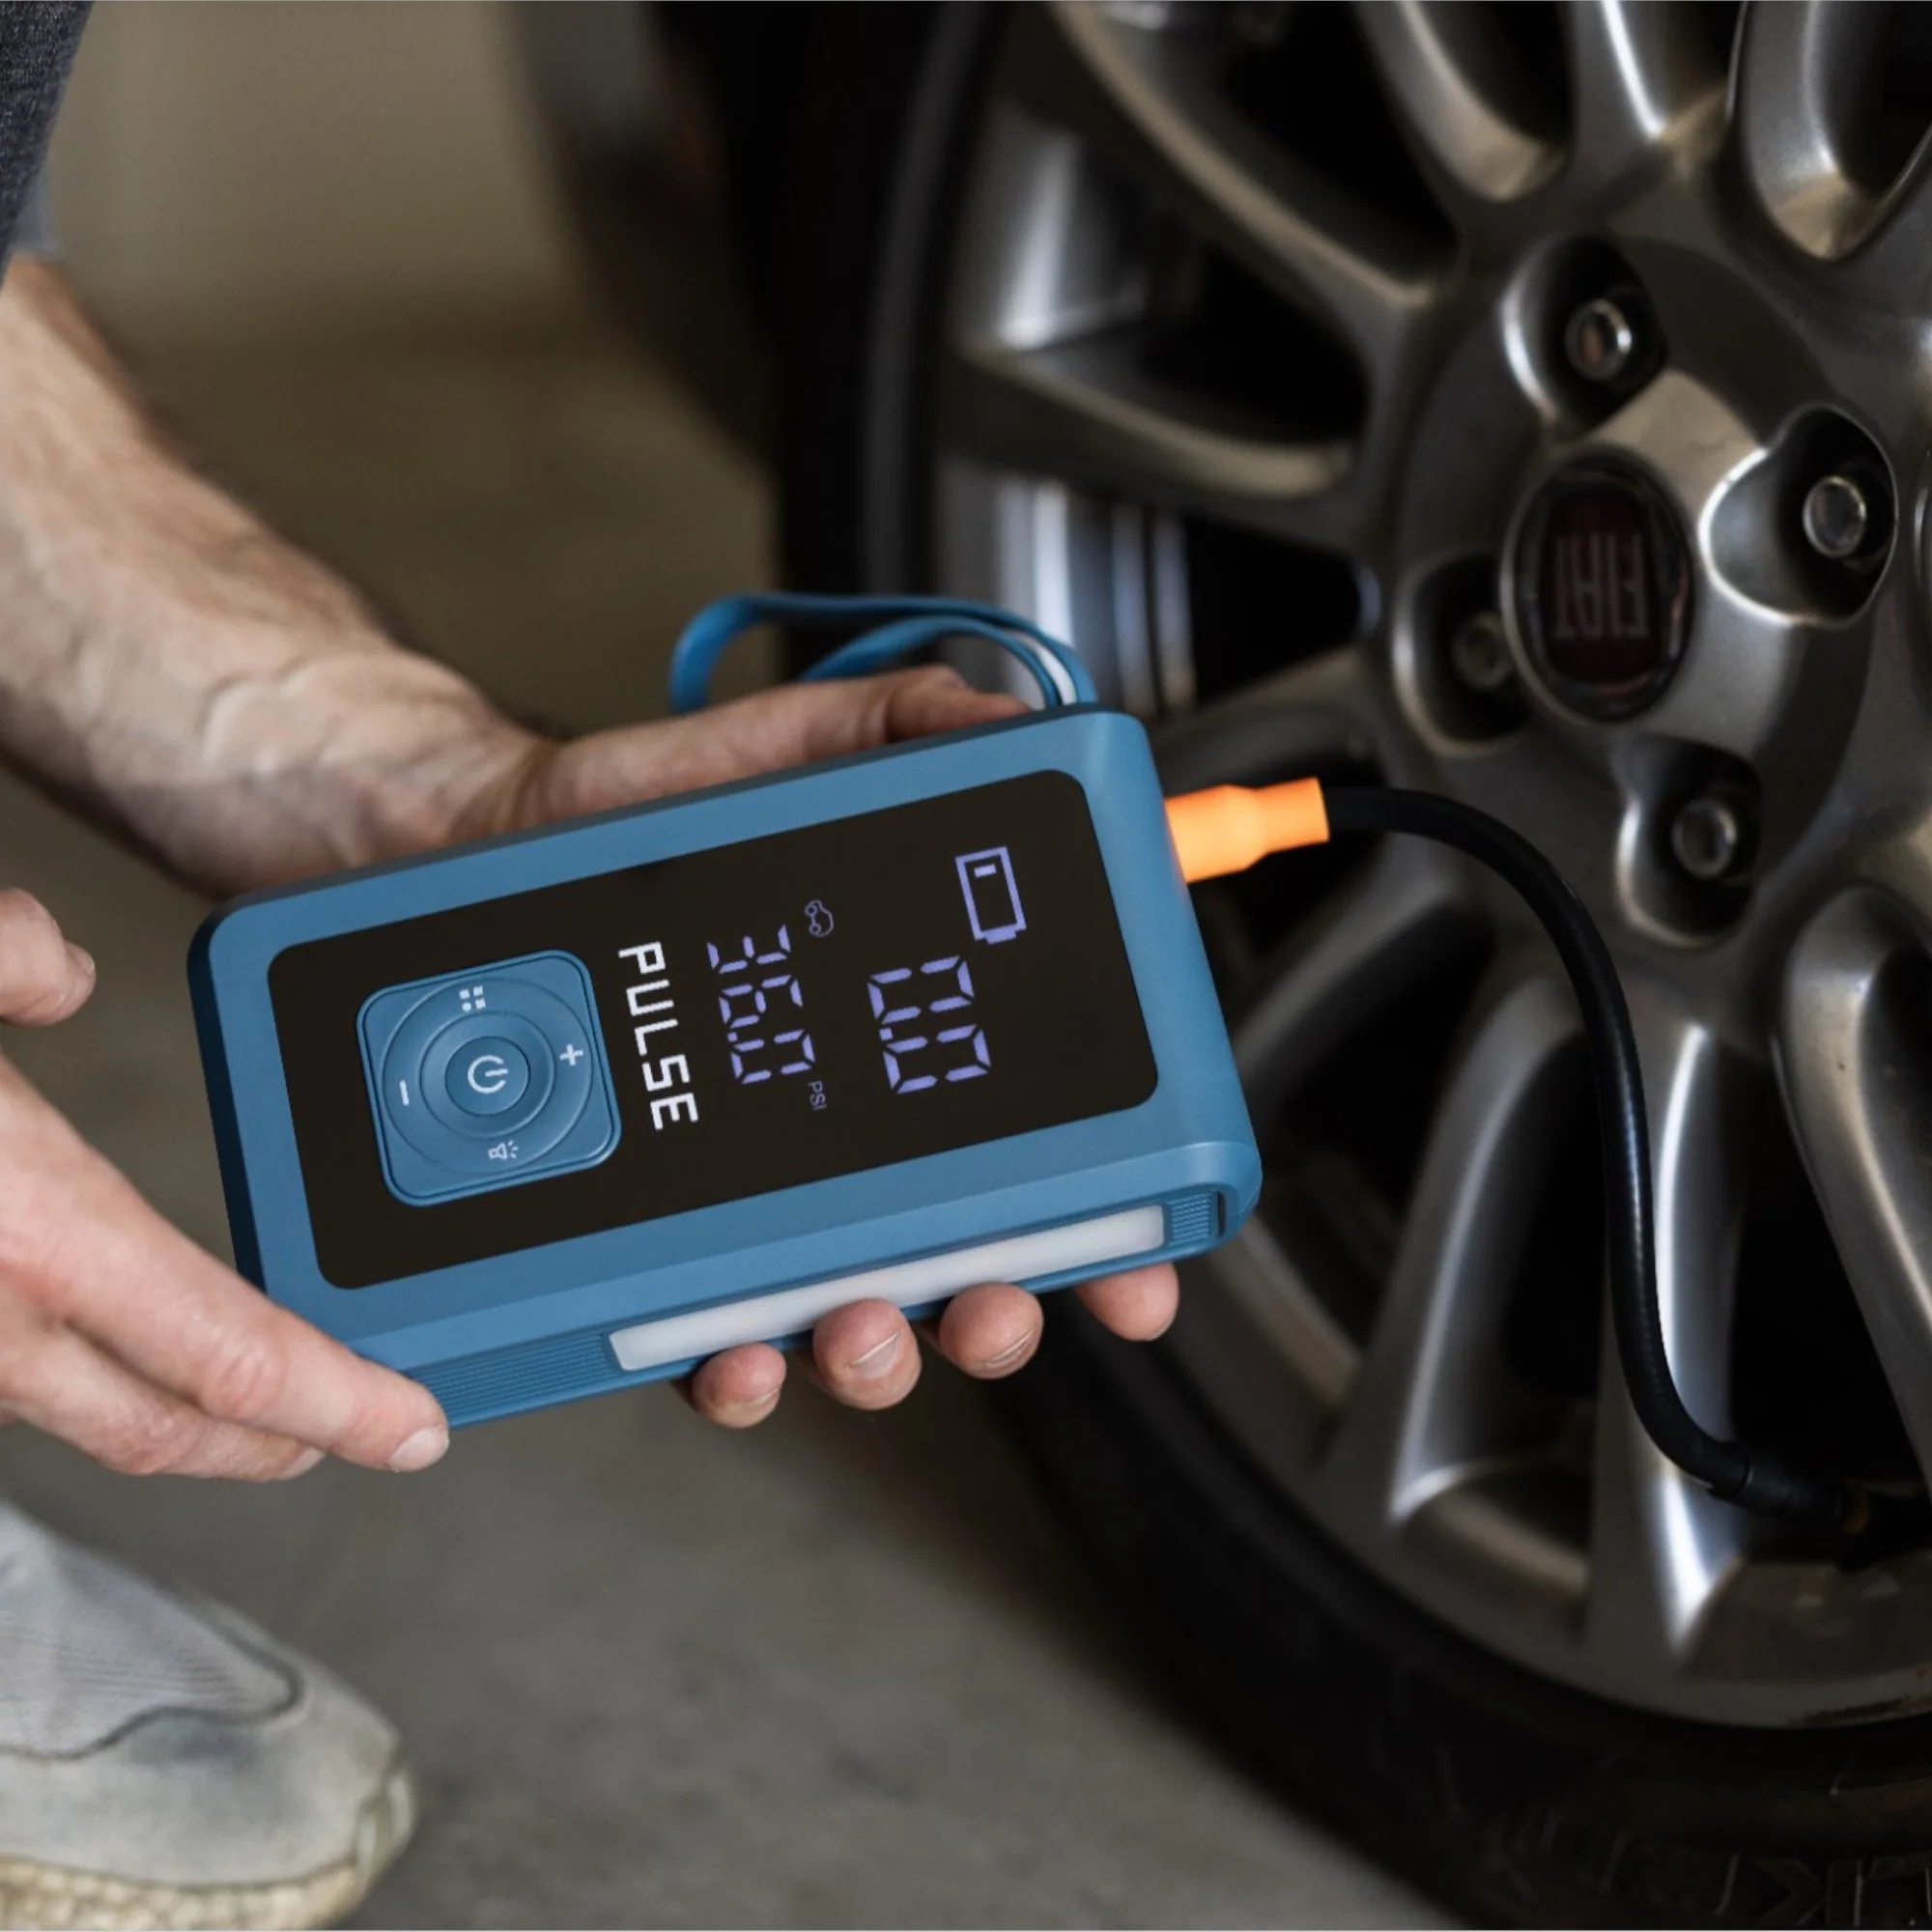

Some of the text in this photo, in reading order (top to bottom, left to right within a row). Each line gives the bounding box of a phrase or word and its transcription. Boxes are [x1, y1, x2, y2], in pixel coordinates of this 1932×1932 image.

[1553, 533, 1649, 640] FIAT
[617, 941, 698, 1131] PULSE
[706, 923, 827, 1111] 36.0 PSI
[867, 955, 991, 1094] 0.0
